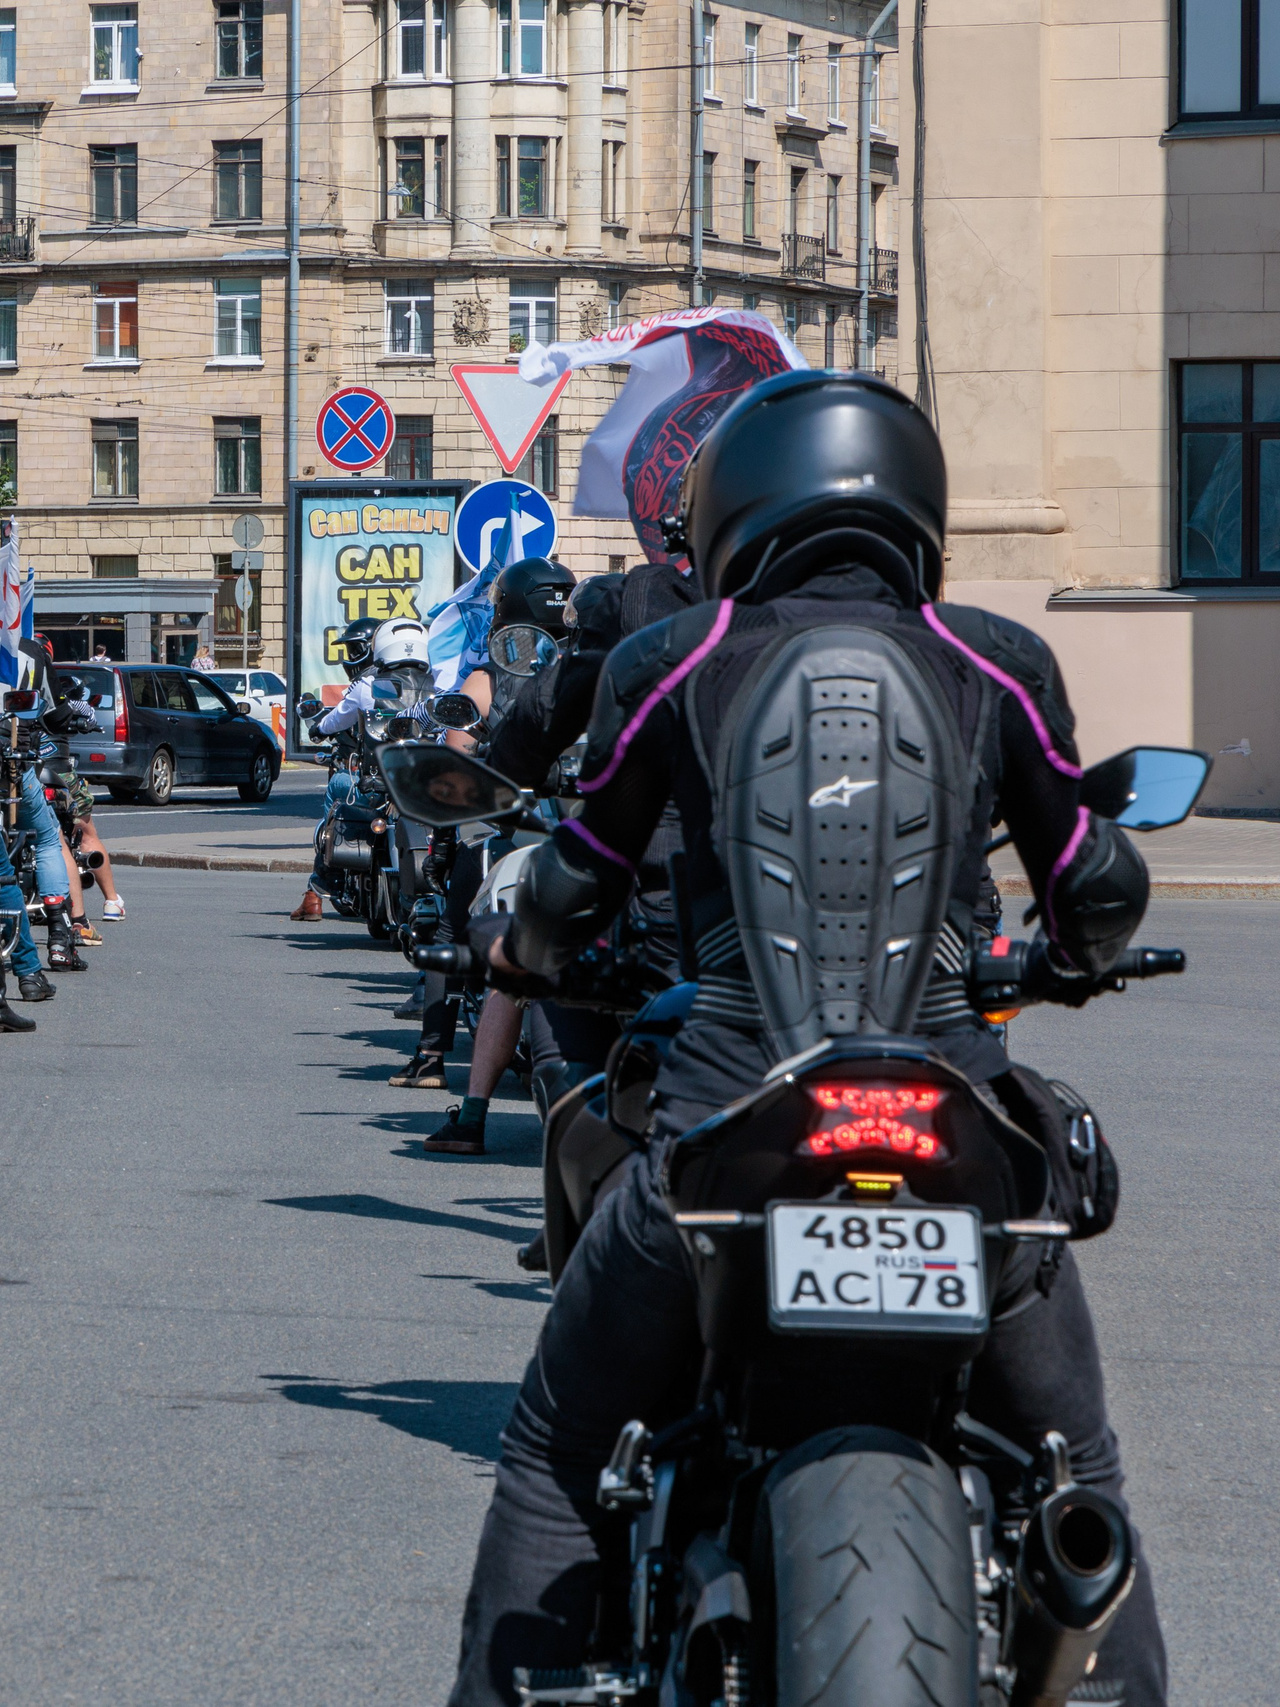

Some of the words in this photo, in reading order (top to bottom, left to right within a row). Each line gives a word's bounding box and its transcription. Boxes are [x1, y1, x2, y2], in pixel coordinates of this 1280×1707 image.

[309, 508, 359, 538] Сан
[361, 504, 450, 535] Саныч
[338, 545, 421, 582] САН
[340, 587, 420, 621] ТЕХ
[803, 1213, 947, 1251] 4850
[875, 1255, 923, 1269] RUS
[789, 1269, 871, 1306] AC
[897, 1272, 967, 1309] 78
